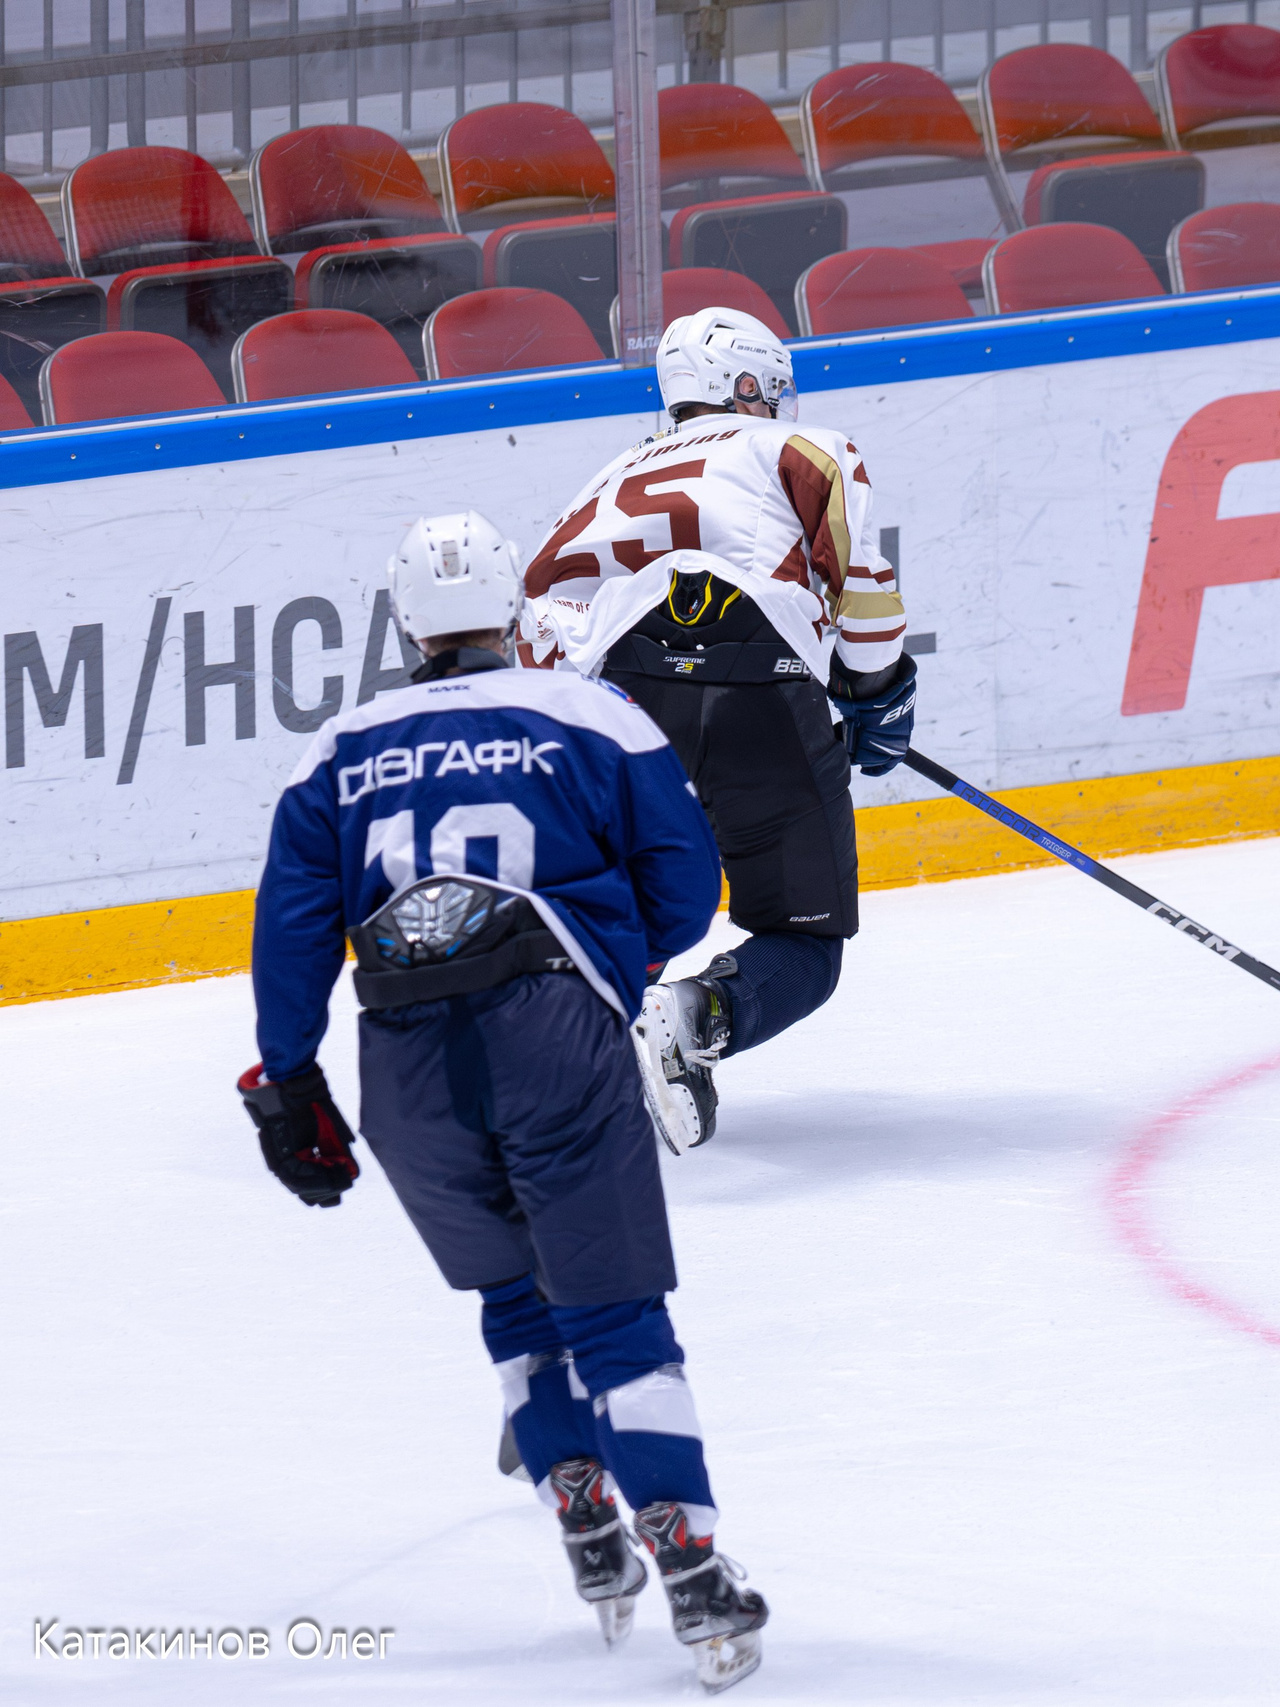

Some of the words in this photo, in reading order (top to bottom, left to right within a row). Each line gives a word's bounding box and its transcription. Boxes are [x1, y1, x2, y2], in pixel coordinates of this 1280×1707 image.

[338, 737, 563, 805] ДВГАФК
[960, 786, 1041, 841] RIBCOR
[1041, 836, 1072, 859] TRIGGER
[789, 912, 830, 922] BAUER
[1146, 900, 1242, 961] CCM
